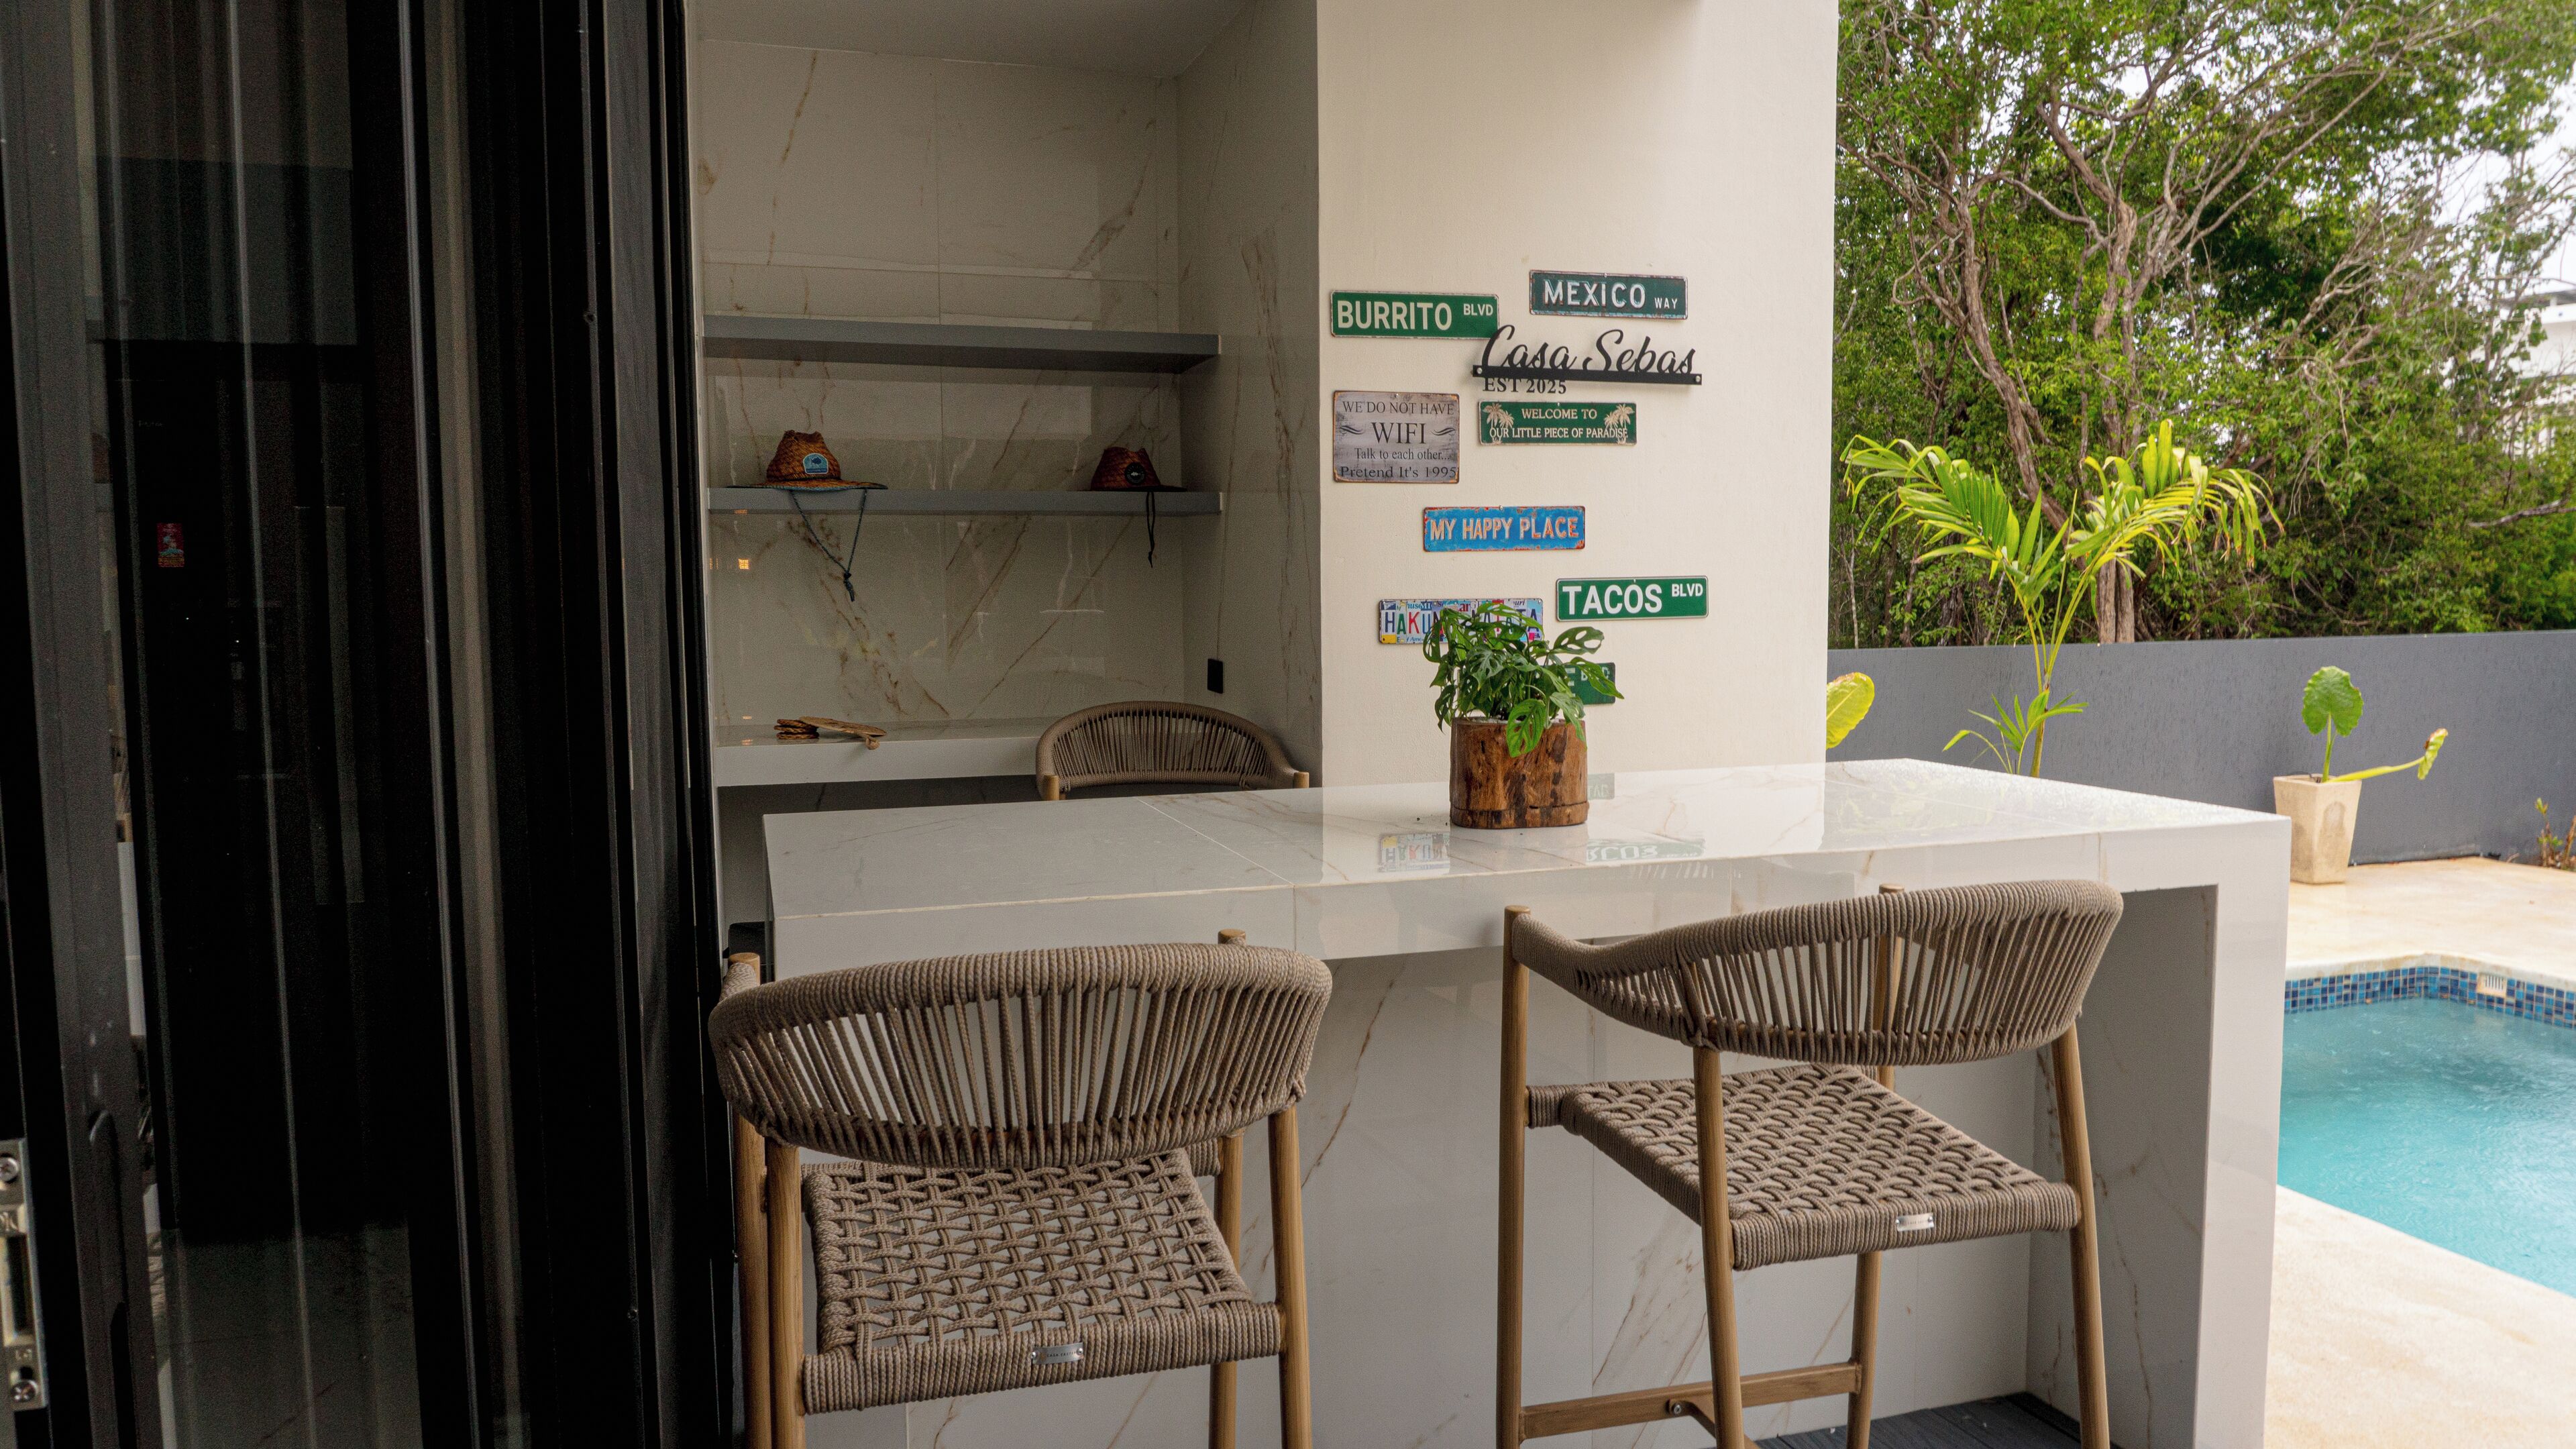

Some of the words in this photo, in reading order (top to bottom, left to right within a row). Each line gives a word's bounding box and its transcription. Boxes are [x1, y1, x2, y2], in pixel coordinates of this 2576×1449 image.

[1543, 279, 1646, 309] MEXICO
[1654, 297, 1678, 310] WAY
[1337, 300, 1452, 331] BURRITO
[1463, 303, 1494, 317] BLVD
[1482, 325, 1577, 370] Casa
[1582, 329, 1695, 374] Sebas
[1483, 378, 1521, 392] EST
[1526, 379, 1566, 394] 2025
[1342, 401, 1362, 413] WE
[1367, 402, 1385, 413] DO
[1390, 402, 1417, 414] NOT
[1420, 403, 1454, 415] HAVE
[1521, 408, 1578, 419] WELCOME
[1581, 409, 1597, 419] TO
[1371, 422, 1426, 444] WIFI
[1490, 427, 1509, 438] OUR
[1512, 427, 1542, 438] LITTLE
[1544, 427, 1569, 438] PIECE
[1571, 427, 1584, 438] OF
[1587, 427, 1628, 437] PARADISE
[1354, 448, 1375, 460] Talk
[1379, 450, 1389, 460] to
[1392, 449, 1414, 460] each
[1341, 466, 1393, 478] Pretend
[1399, 466, 1418, 478] It's
[1426, 467, 1456, 478] 1995
[1430, 519, 1456, 540] MY
[1462, 518, 1513, 539] HAPPY
[1519, 517, 1579, 539] PLACE
[1562, 584, 1662, 615] TACOS
[1671, 584, 1704, 598] BLVD
[1385, 611, 1445, 635] HAKUN
